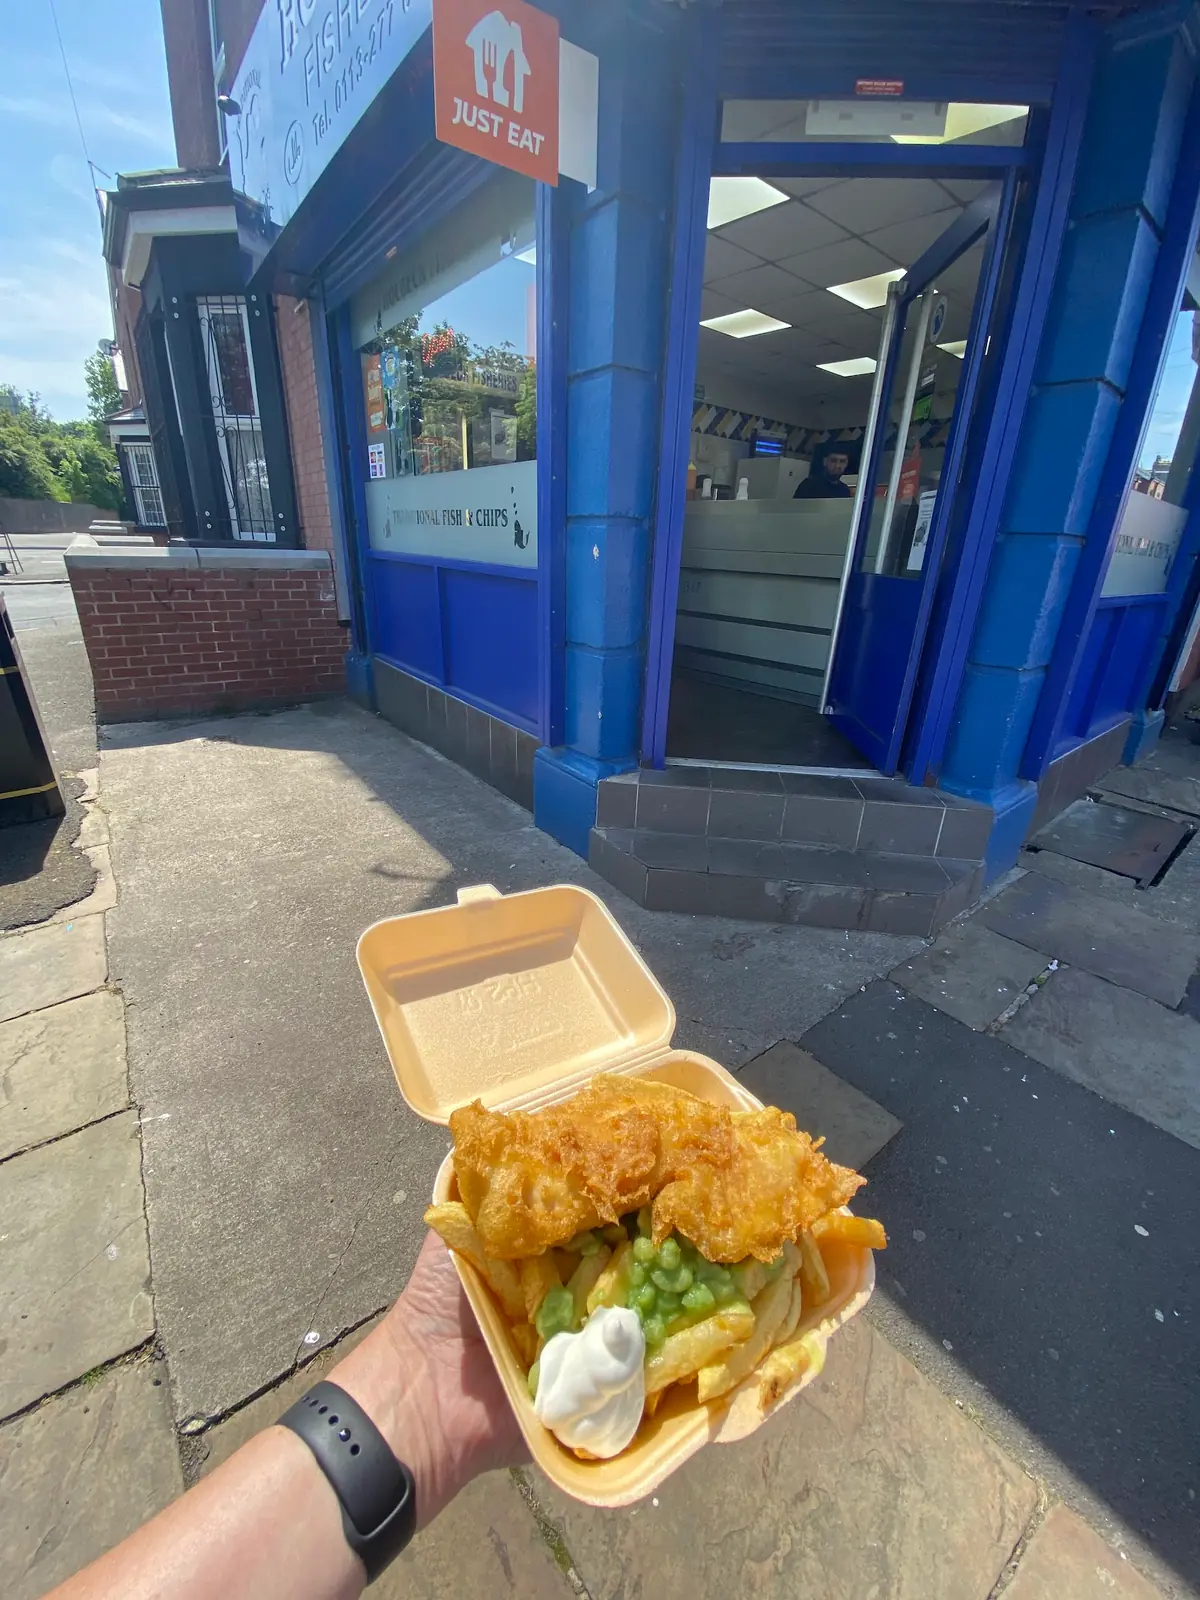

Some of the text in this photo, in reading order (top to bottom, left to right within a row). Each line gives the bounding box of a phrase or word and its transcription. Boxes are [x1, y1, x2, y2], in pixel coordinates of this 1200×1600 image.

[312, 100, 332, 146] Tel.
[452, 97, 545, 155] JUST EAT
[442, 509, 462, 526] FISH
[476, 508, 508, 527] CHIPS
